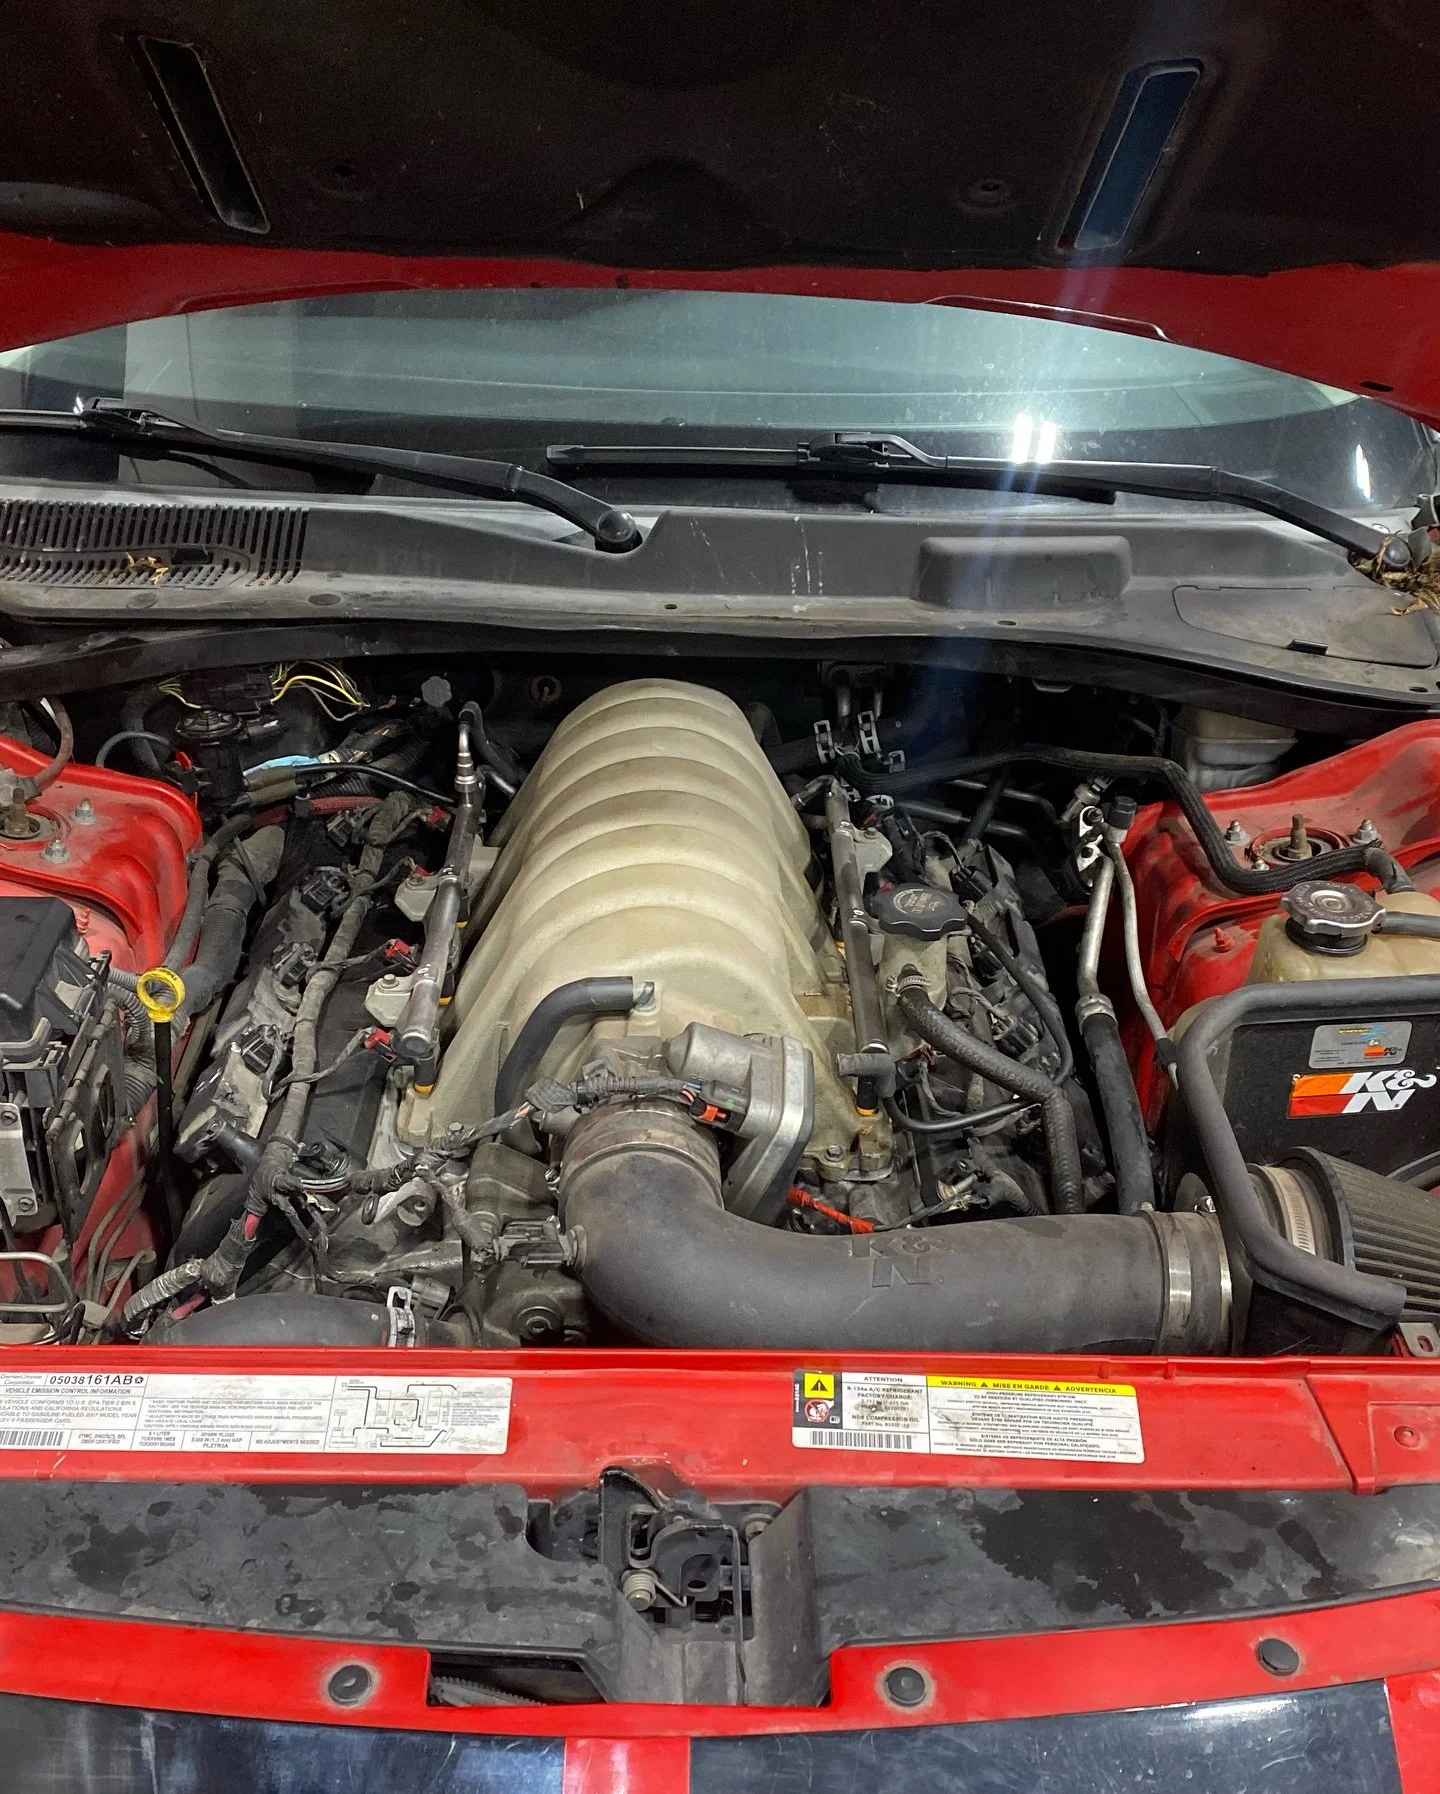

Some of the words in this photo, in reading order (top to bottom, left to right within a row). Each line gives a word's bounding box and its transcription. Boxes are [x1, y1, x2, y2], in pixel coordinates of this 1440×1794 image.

[1339, 1069, 1437, 1113] K&N
[50, 1375, 134, 1386] 05038161AB
[941, 1380, 977, 1388] WARNING
[1024, 1384, 1050, 1392] GARDE
[1065, 1386, 1117, 1394] ADVERTENCIA
